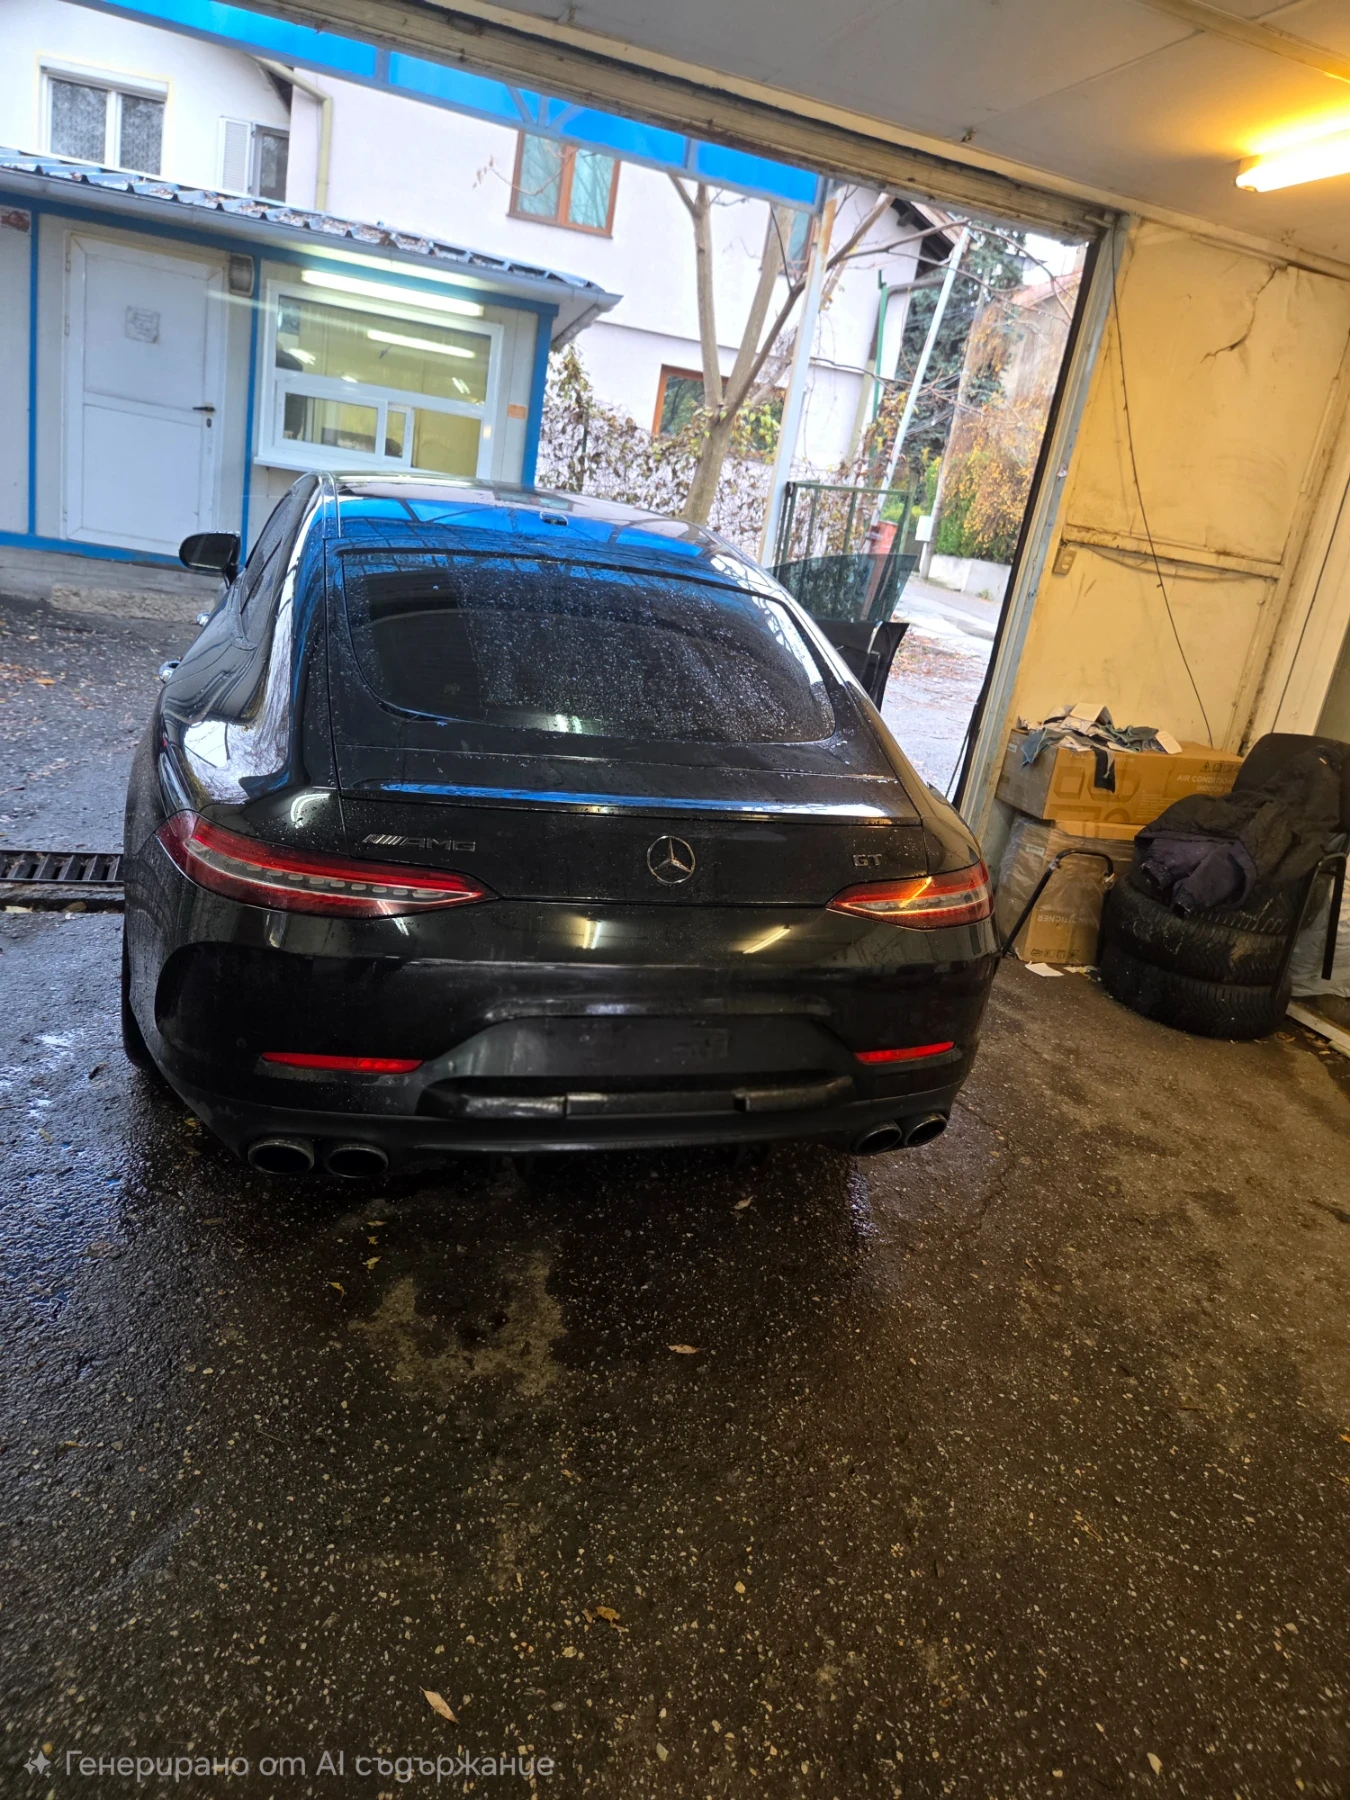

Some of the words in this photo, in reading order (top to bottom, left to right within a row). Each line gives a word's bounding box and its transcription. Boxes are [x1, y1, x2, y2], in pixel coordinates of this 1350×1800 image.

[1176, 774, 1191, 782] AIR
[1191, 775, 1235, 786] CONDITION
[400, 836, 476, 852] AMG
[853, 853, 882, 867] GT
